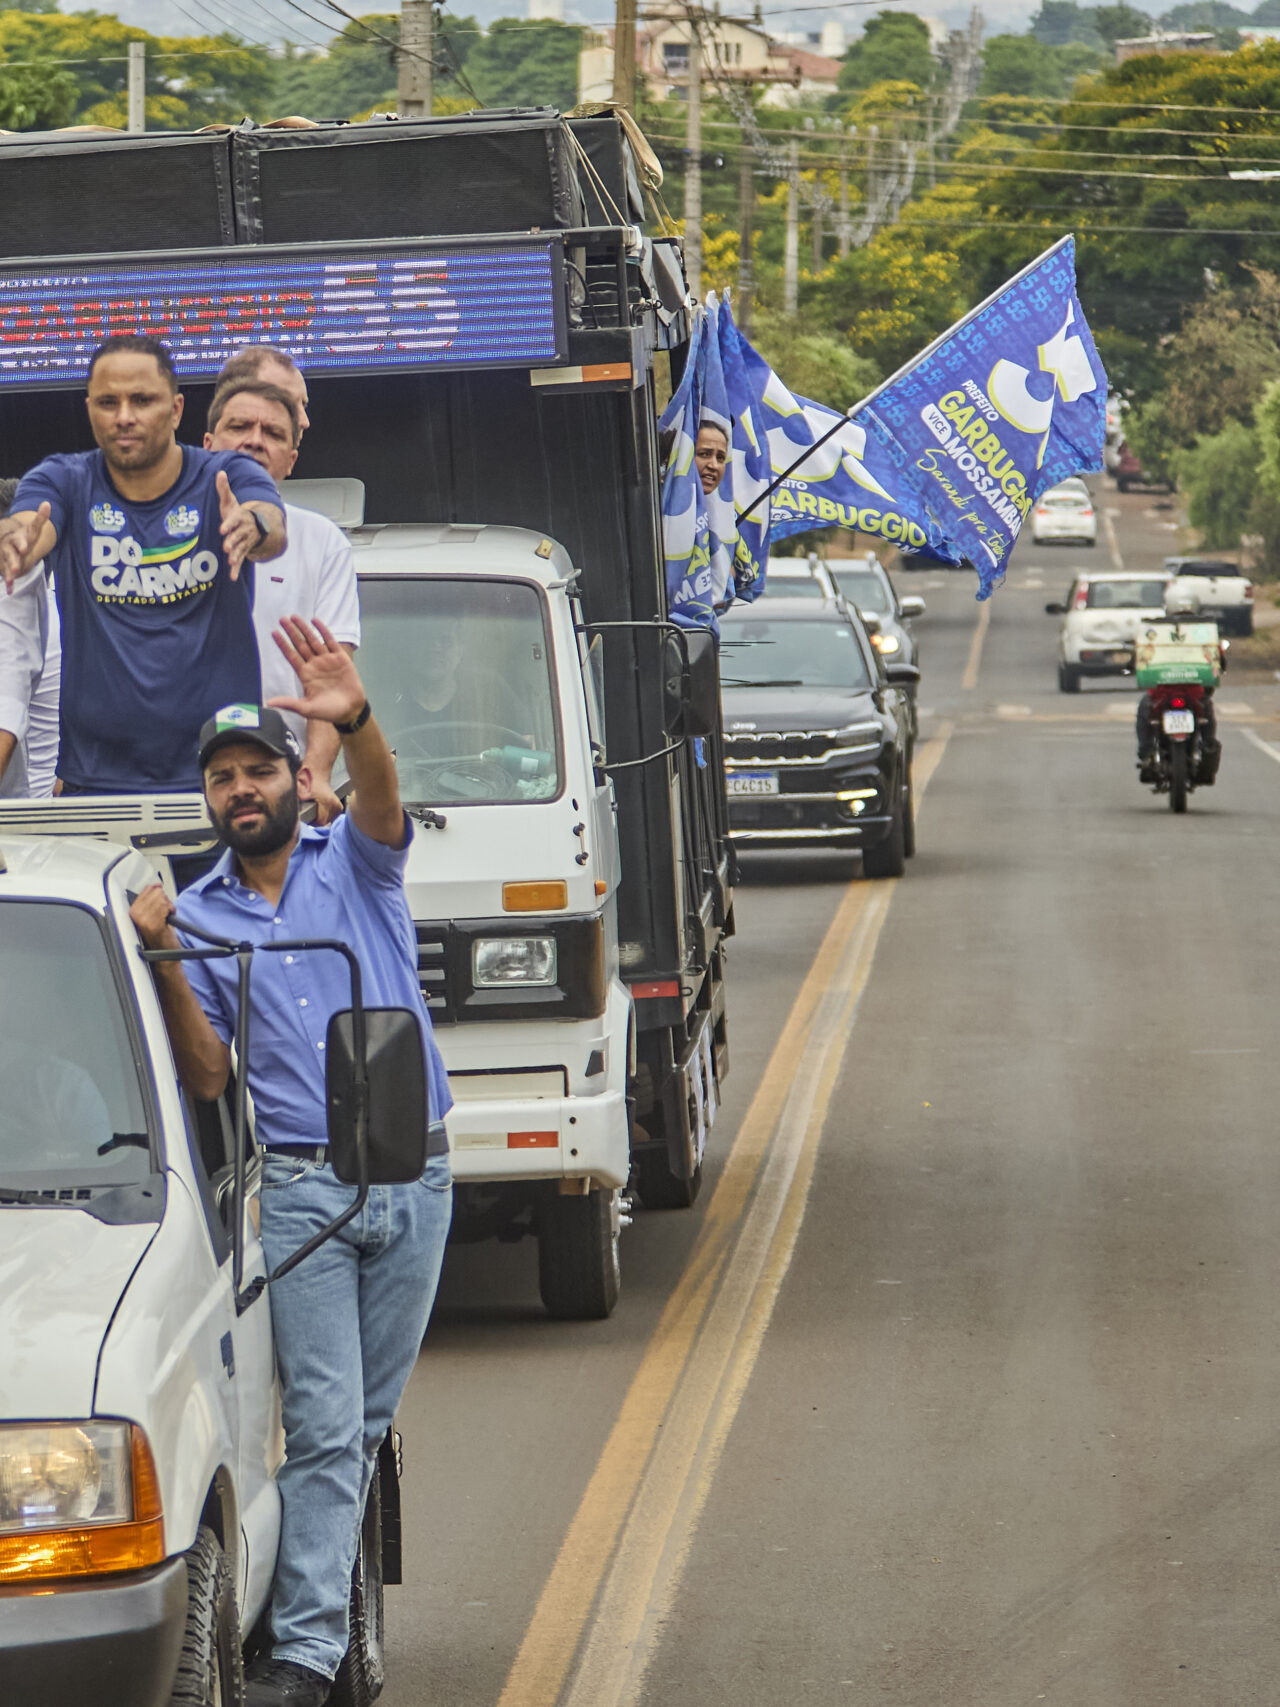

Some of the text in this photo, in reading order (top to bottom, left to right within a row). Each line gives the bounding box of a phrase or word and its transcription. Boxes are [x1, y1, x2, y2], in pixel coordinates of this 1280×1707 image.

[961, 379, 999, 421] PREFEITO
[928, 412, 1022, 540] VICE MOSSAMBA
[939, 390, 1032, 522] GARBUG
[917, 448, 976, 510] Sarandi
[958, 511, 988, 536] pra
[104, 510, 125, 526] 55
[177, 510, 199, 527] 55
[771, 488, 927, 547] ARBUGGIO
[91, 536, 143, 567] DO
[91, 550, 218, 597] CARMO
